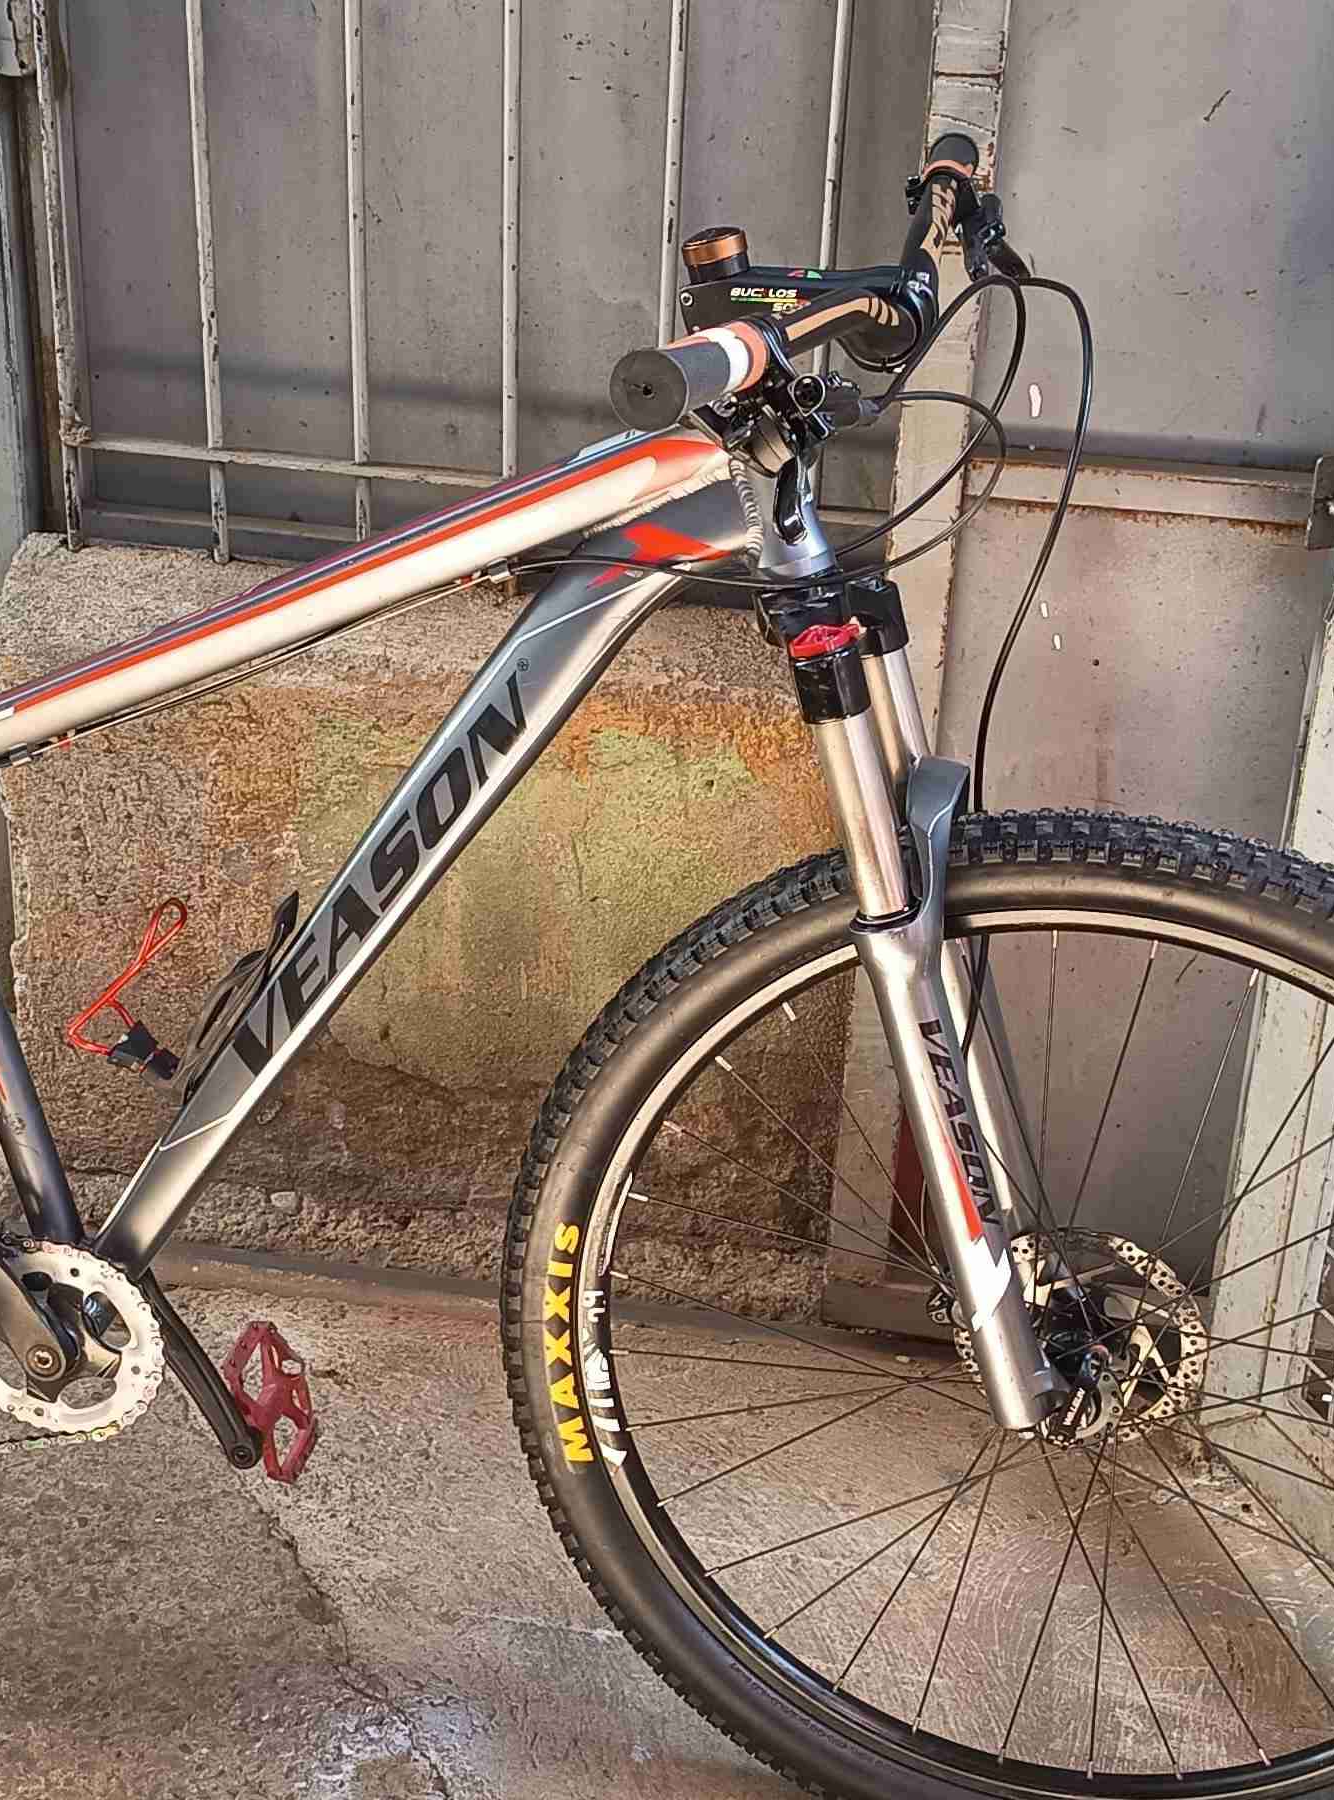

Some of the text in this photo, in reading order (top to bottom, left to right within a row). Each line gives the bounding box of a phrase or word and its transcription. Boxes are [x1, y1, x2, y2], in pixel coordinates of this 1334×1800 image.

[730, 287, 798, 298] BUCLOS
[233, 671, 528, 1077] VEASON
[918, 1018, 1001, 1225] VEASON
[543, 1221, 595, 1463] MAXXIS
